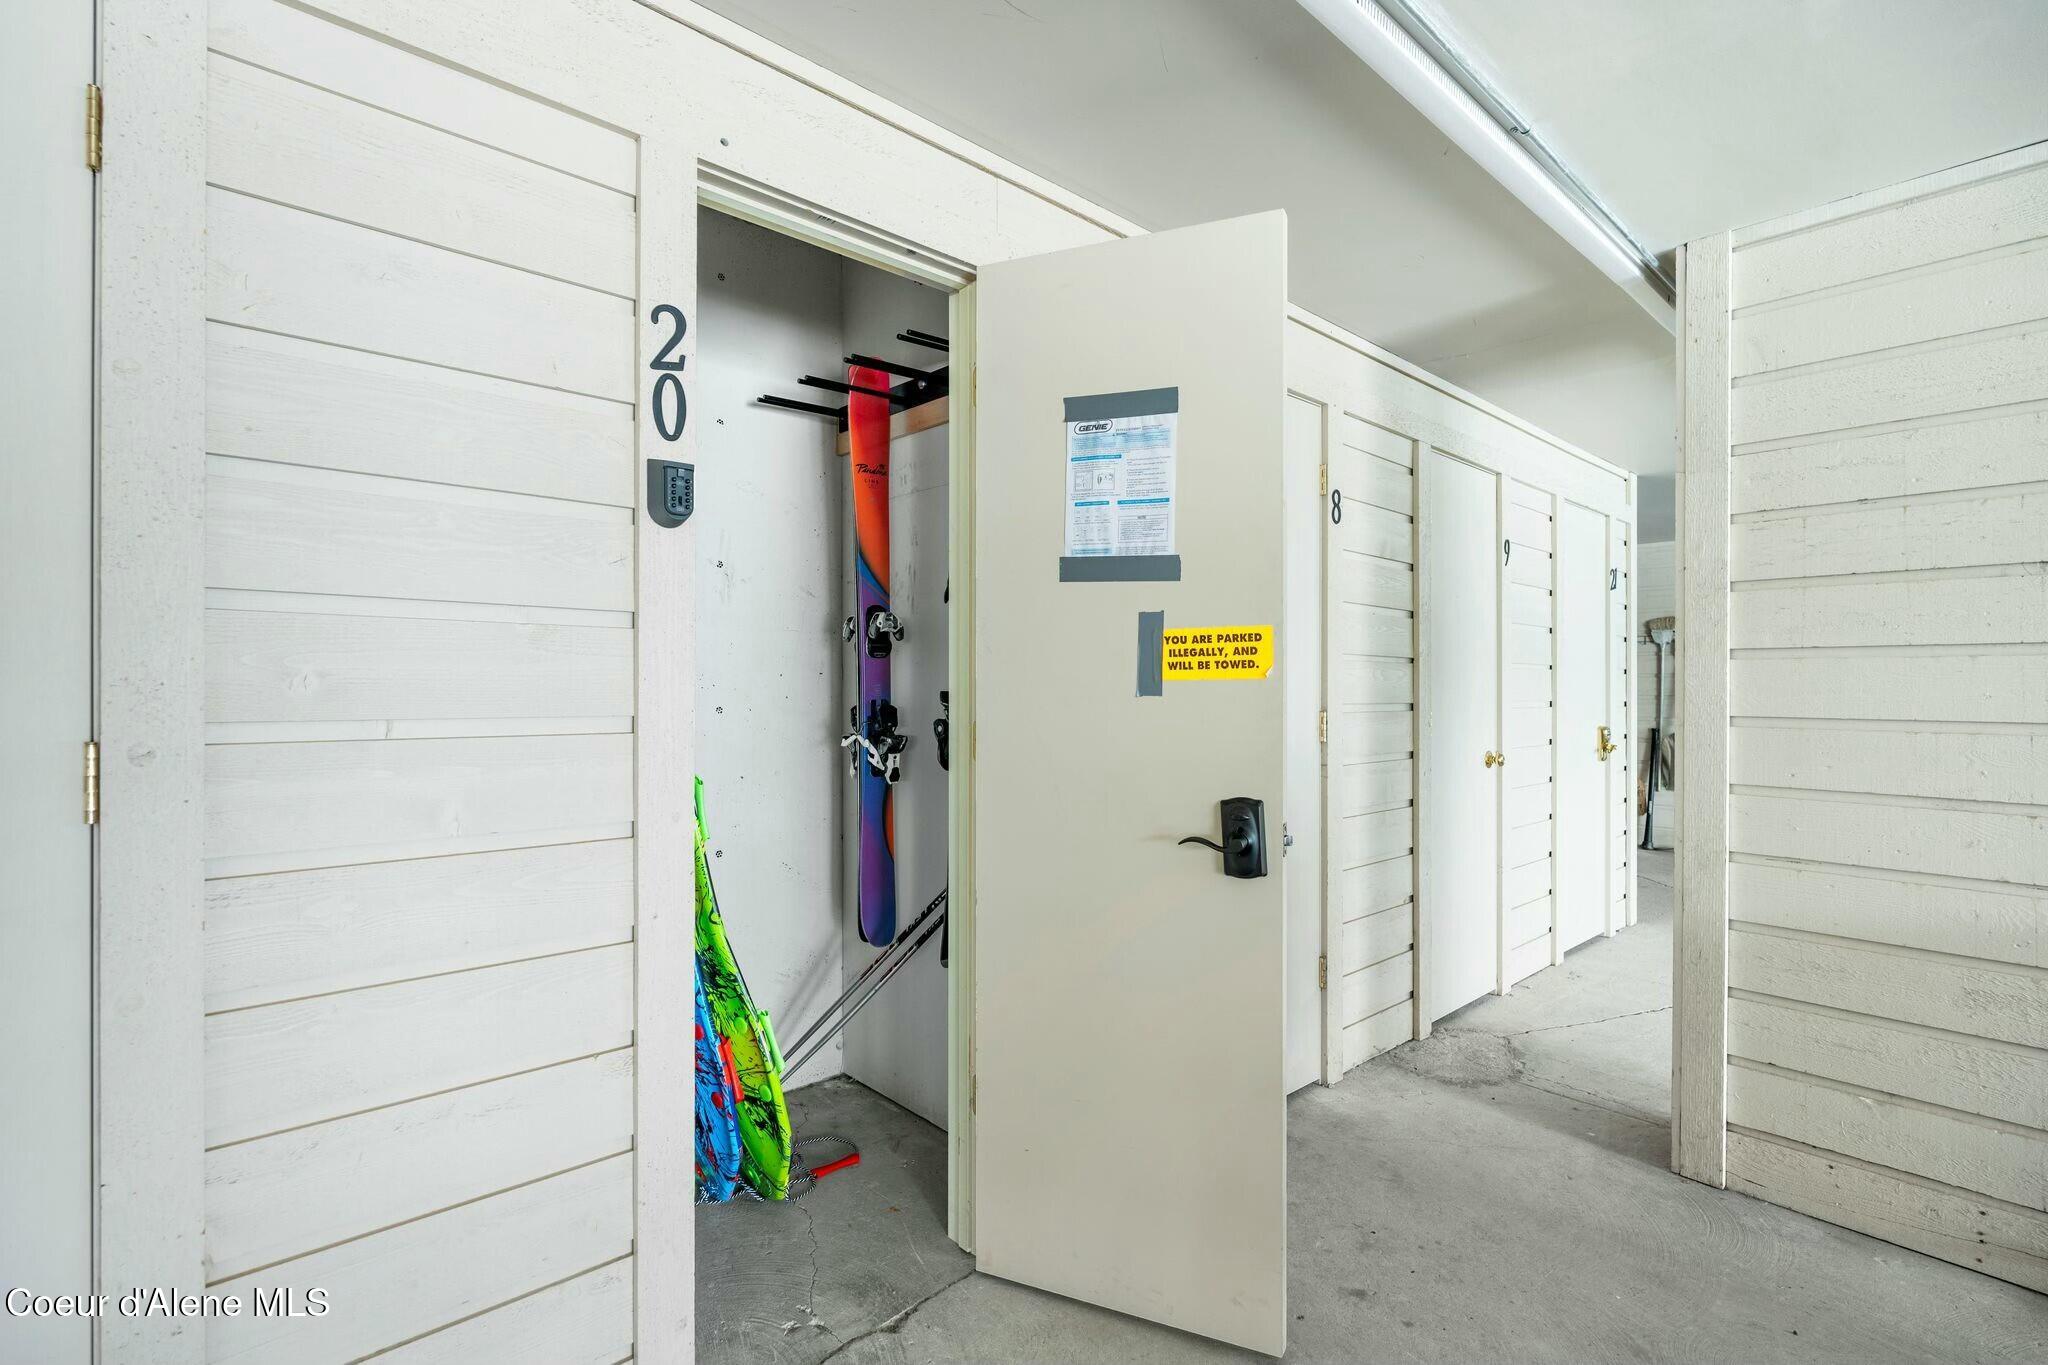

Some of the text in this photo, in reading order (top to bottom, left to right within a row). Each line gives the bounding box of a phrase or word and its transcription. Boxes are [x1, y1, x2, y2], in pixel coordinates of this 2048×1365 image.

[650, 304, 687, 442] 20
[1078, 423, 1108, 432] GENIE
[1331, 489, 1342, 524] 8
[1503, 539, 1510, 566] 9
[1610, 567, 1617, 590] 21
[1164, 633, 1262, 645] YOU ARE PARKED
[1168, 646, 1258, 658] ILLEGALLY, AND
[1168, 660, 1259, 670] WILL BE TOWED.
